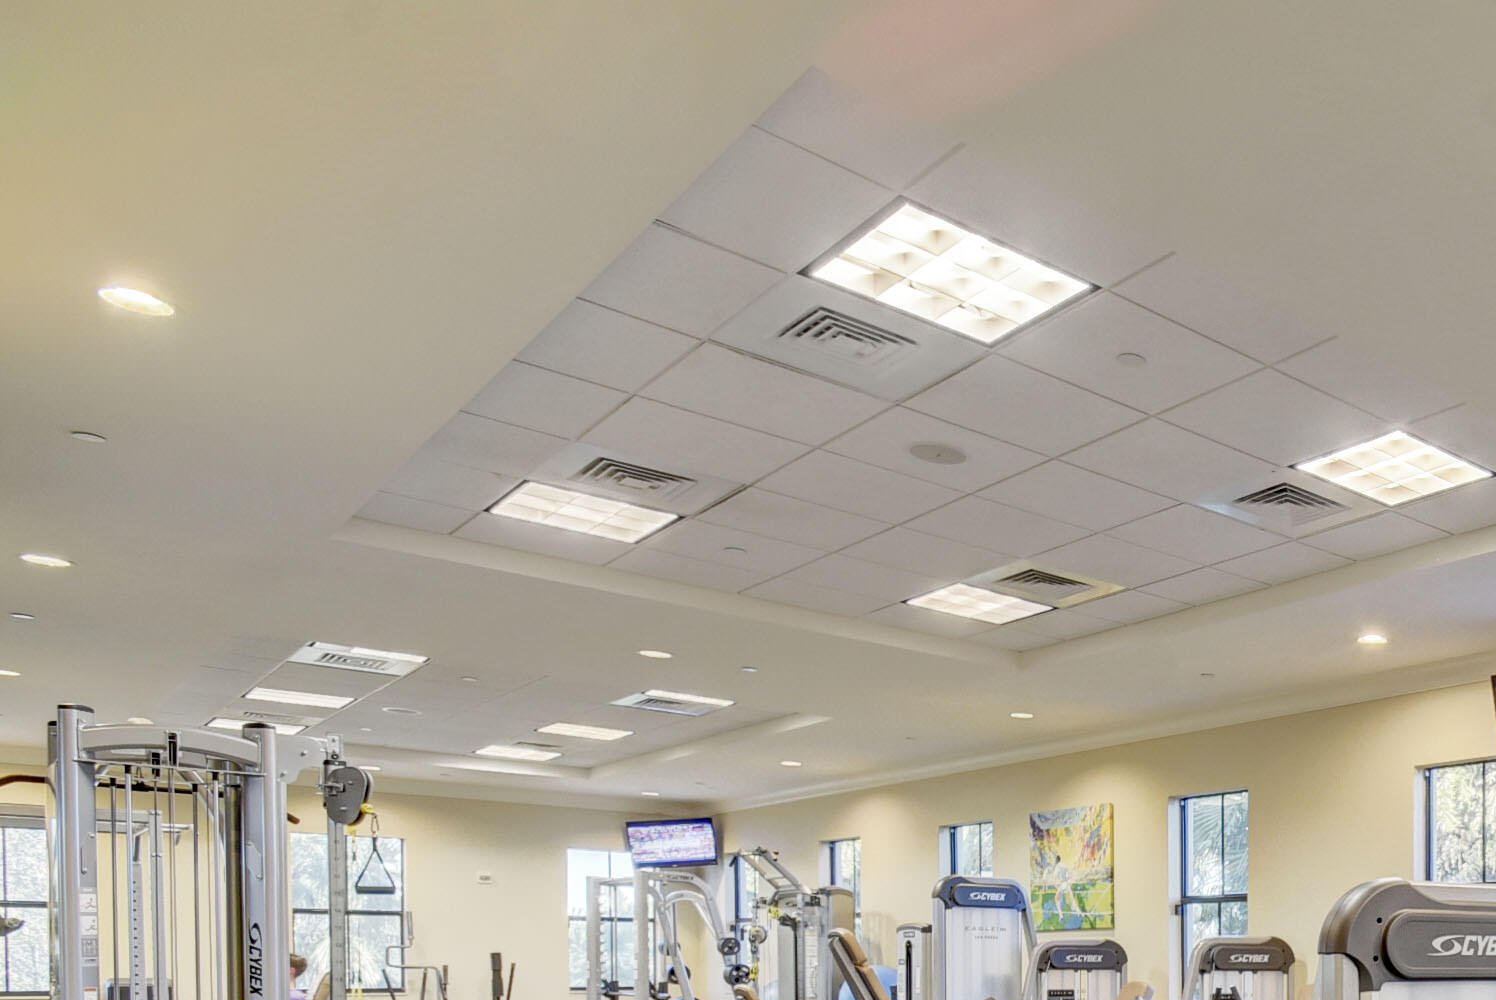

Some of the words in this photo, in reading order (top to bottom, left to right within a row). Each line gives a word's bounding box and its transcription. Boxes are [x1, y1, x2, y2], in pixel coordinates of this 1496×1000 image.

[981, 892, 1006, 901] CYBEX
[1077, 954, 1104, 963] CYBEX
[1242, 953, 1271, 963] CYBEX
[249, 945, 263, 997] CYBEX
